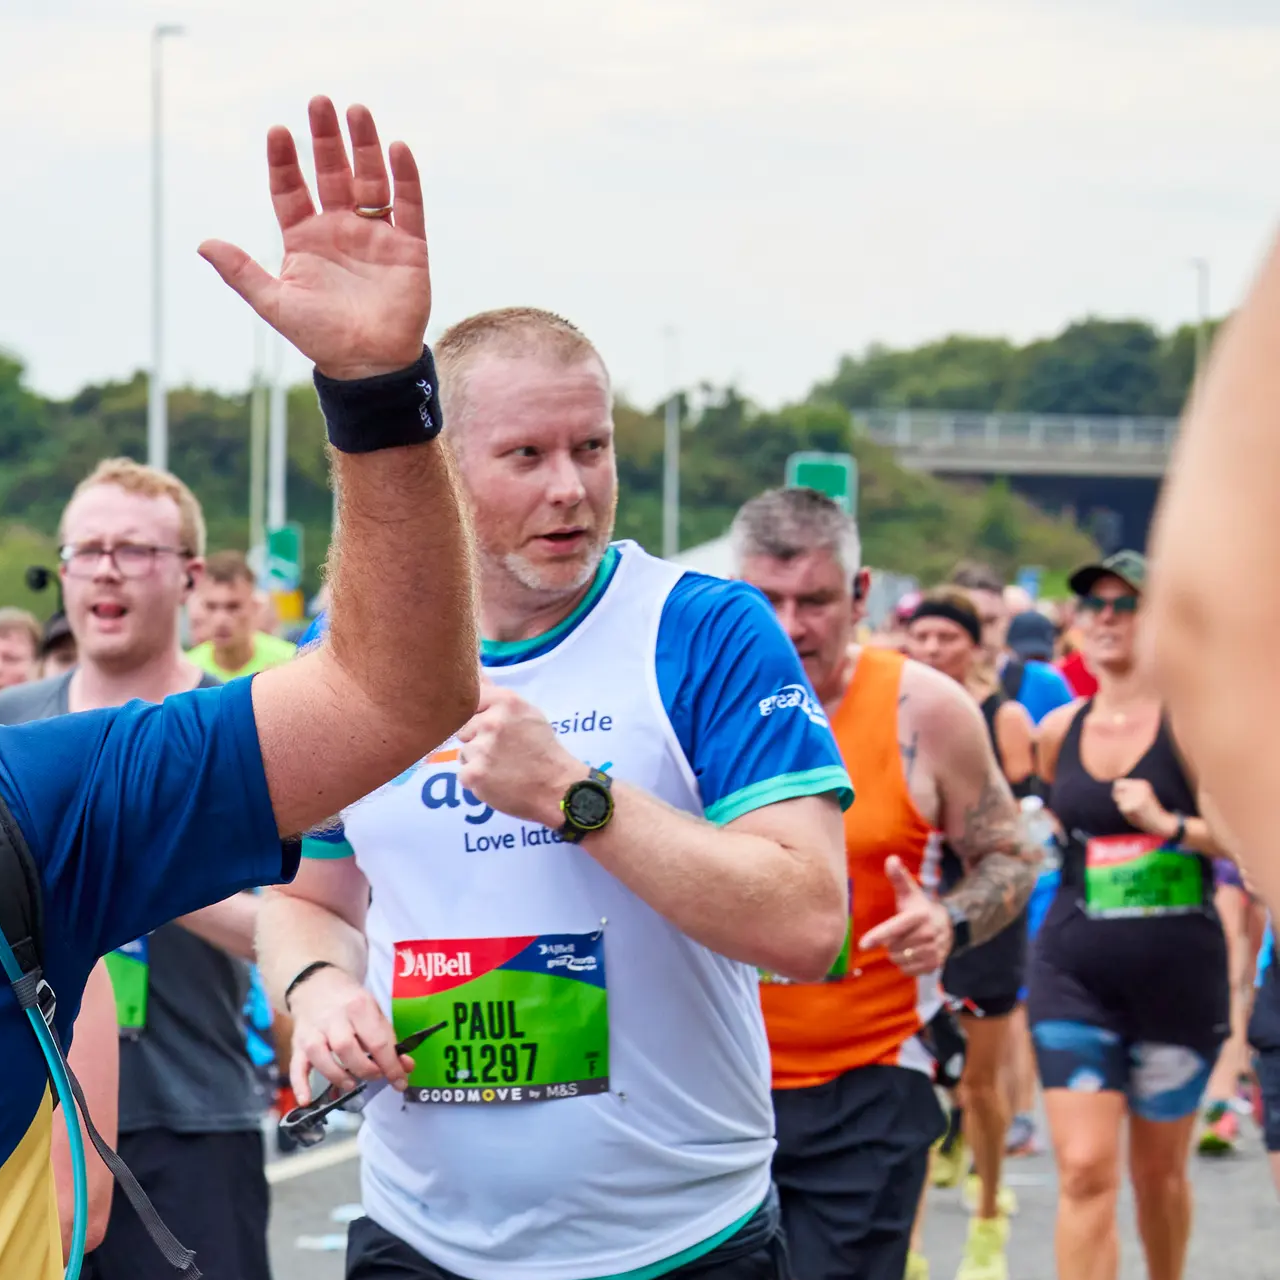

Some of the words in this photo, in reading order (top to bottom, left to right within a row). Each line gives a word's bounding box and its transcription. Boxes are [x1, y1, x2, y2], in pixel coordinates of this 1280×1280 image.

[464, 832, 515, 853] Love
[521, 826, 564, 848] late
[452, 1000, 525, 1041] PAUL
[443, 1043, 539, 1084] 31297
[419, 1087, 522, 1102] GOODMOVE
[546, 1083, 578, 1098] M&S
